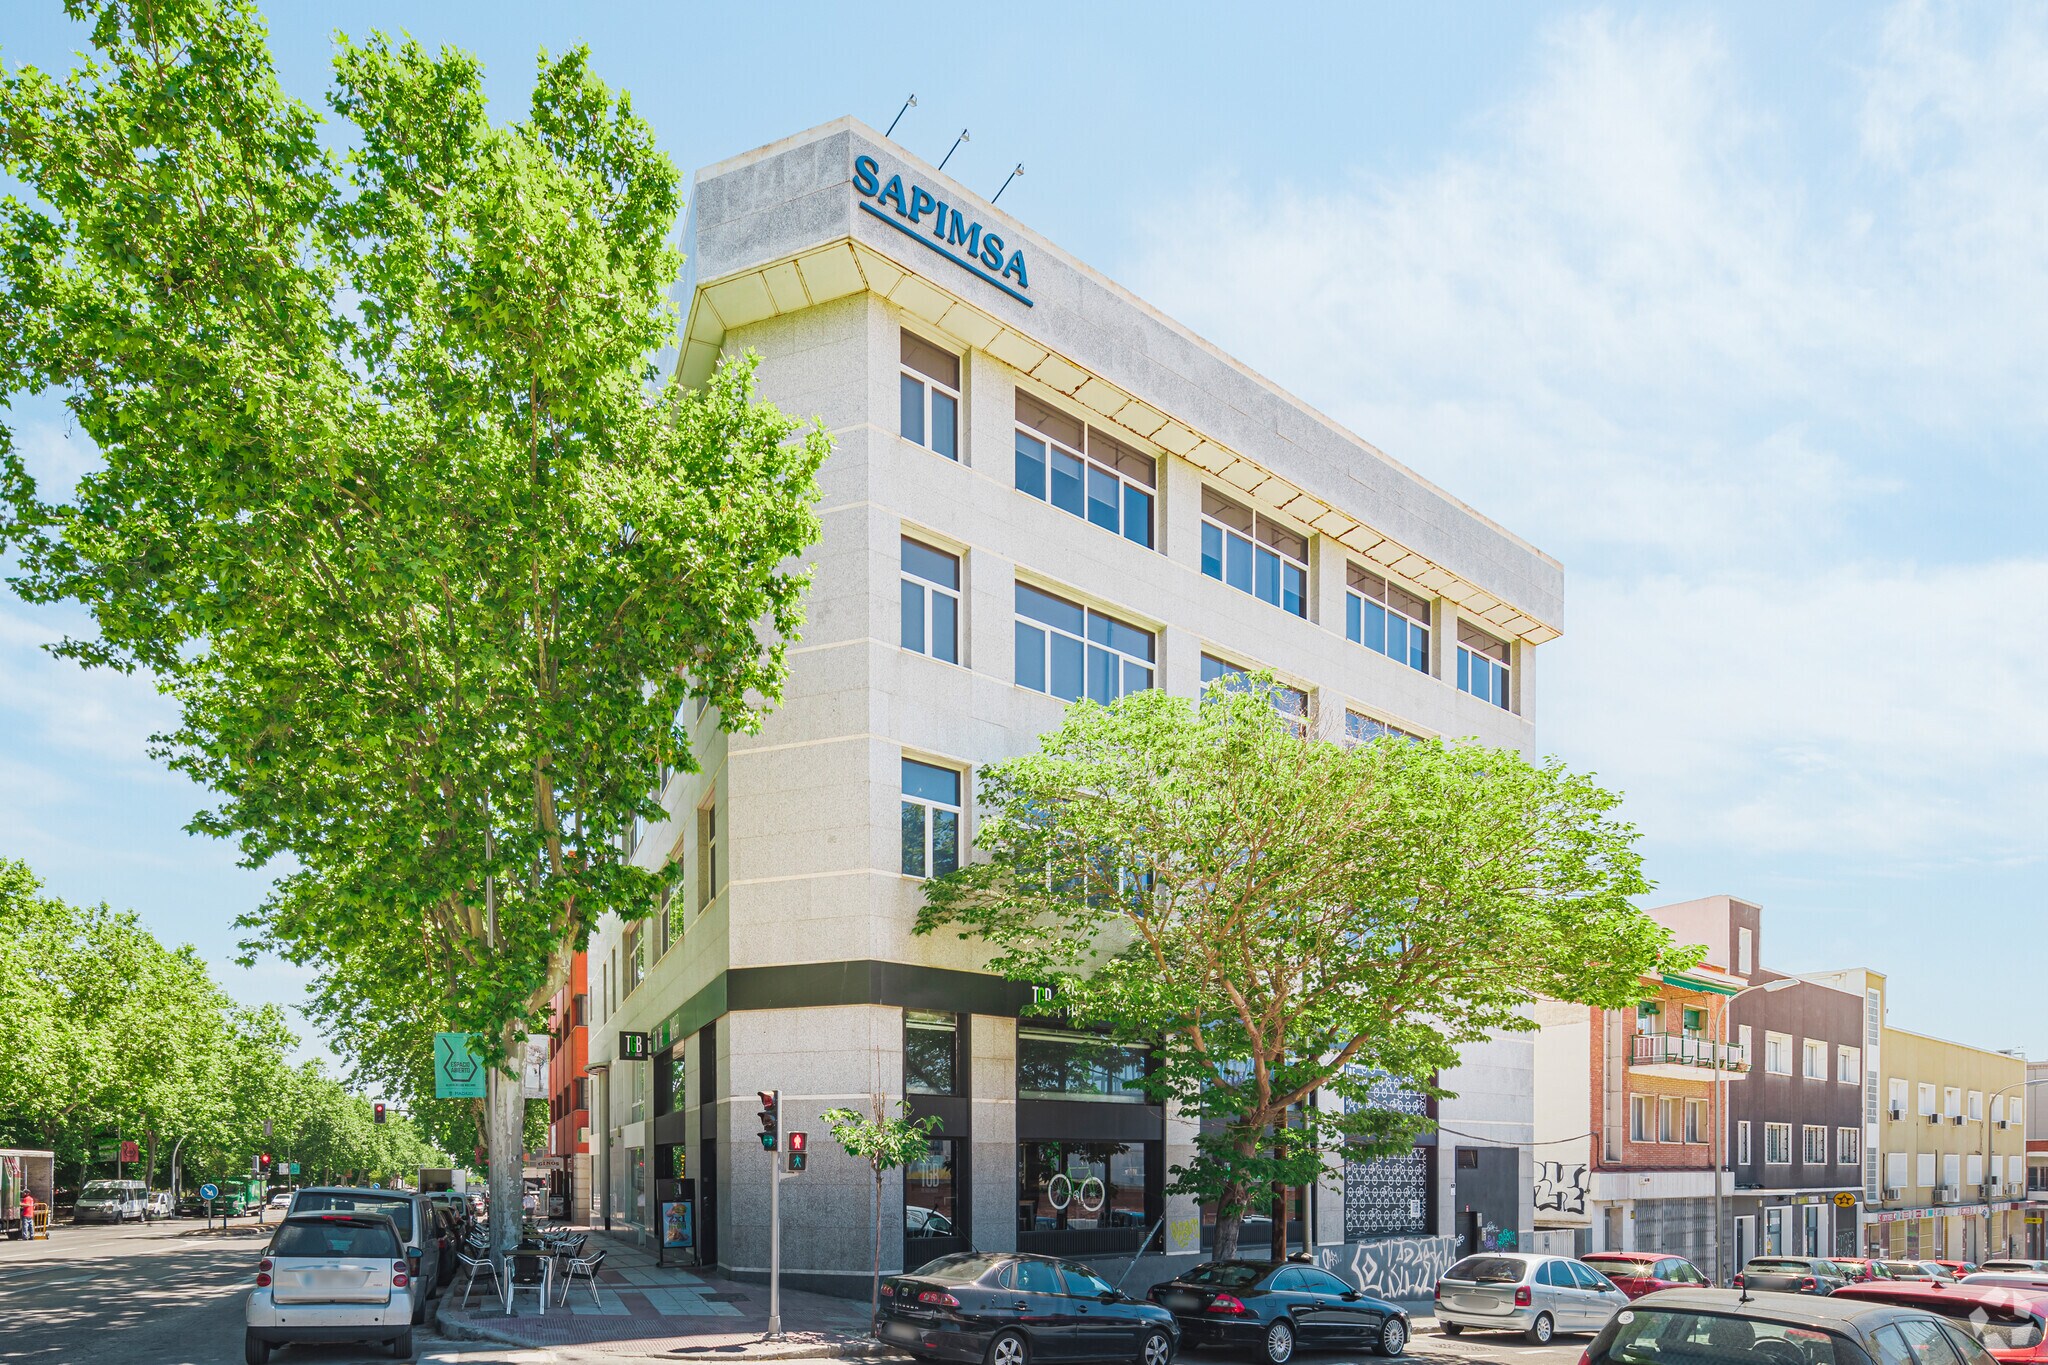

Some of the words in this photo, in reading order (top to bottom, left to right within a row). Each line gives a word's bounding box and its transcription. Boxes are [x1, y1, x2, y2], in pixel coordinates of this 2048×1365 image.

[852, 155, 1029, 289] SAPIMSA
[625, 1035, 643, 1053] TGB
[920, 1163, 940, 1188] TGB
